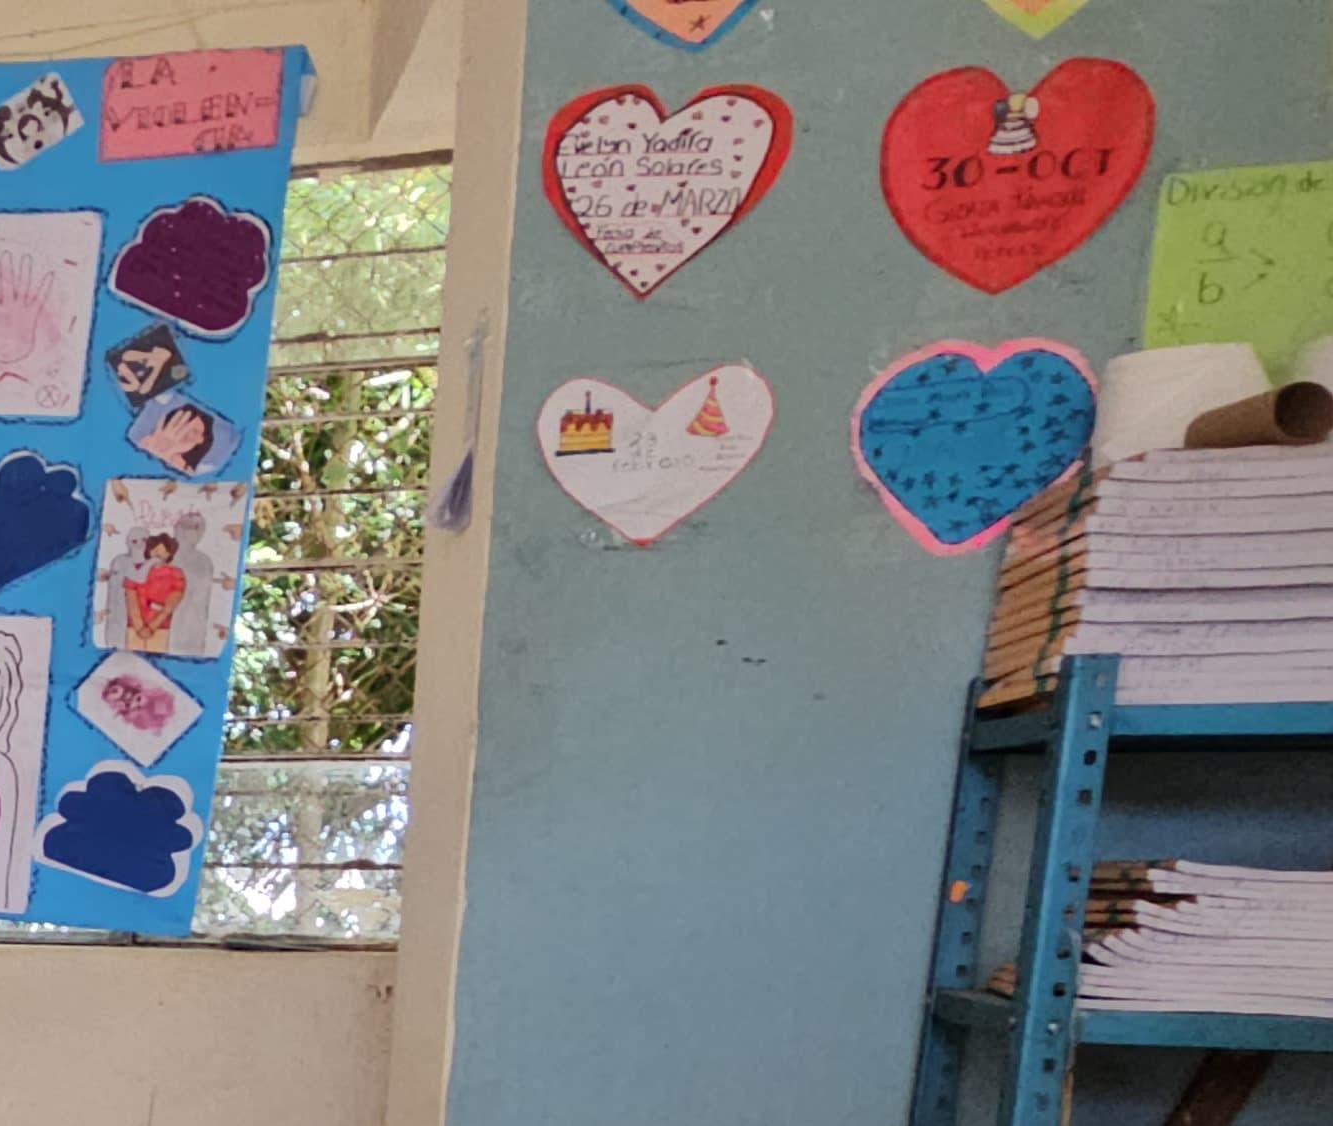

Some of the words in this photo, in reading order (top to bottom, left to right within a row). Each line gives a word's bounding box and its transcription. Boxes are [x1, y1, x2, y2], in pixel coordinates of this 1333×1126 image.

[641, 131, 713, 153] Yadira
[636, 156, 724, 176] Solares
[576, 194, 613, 217] 26
